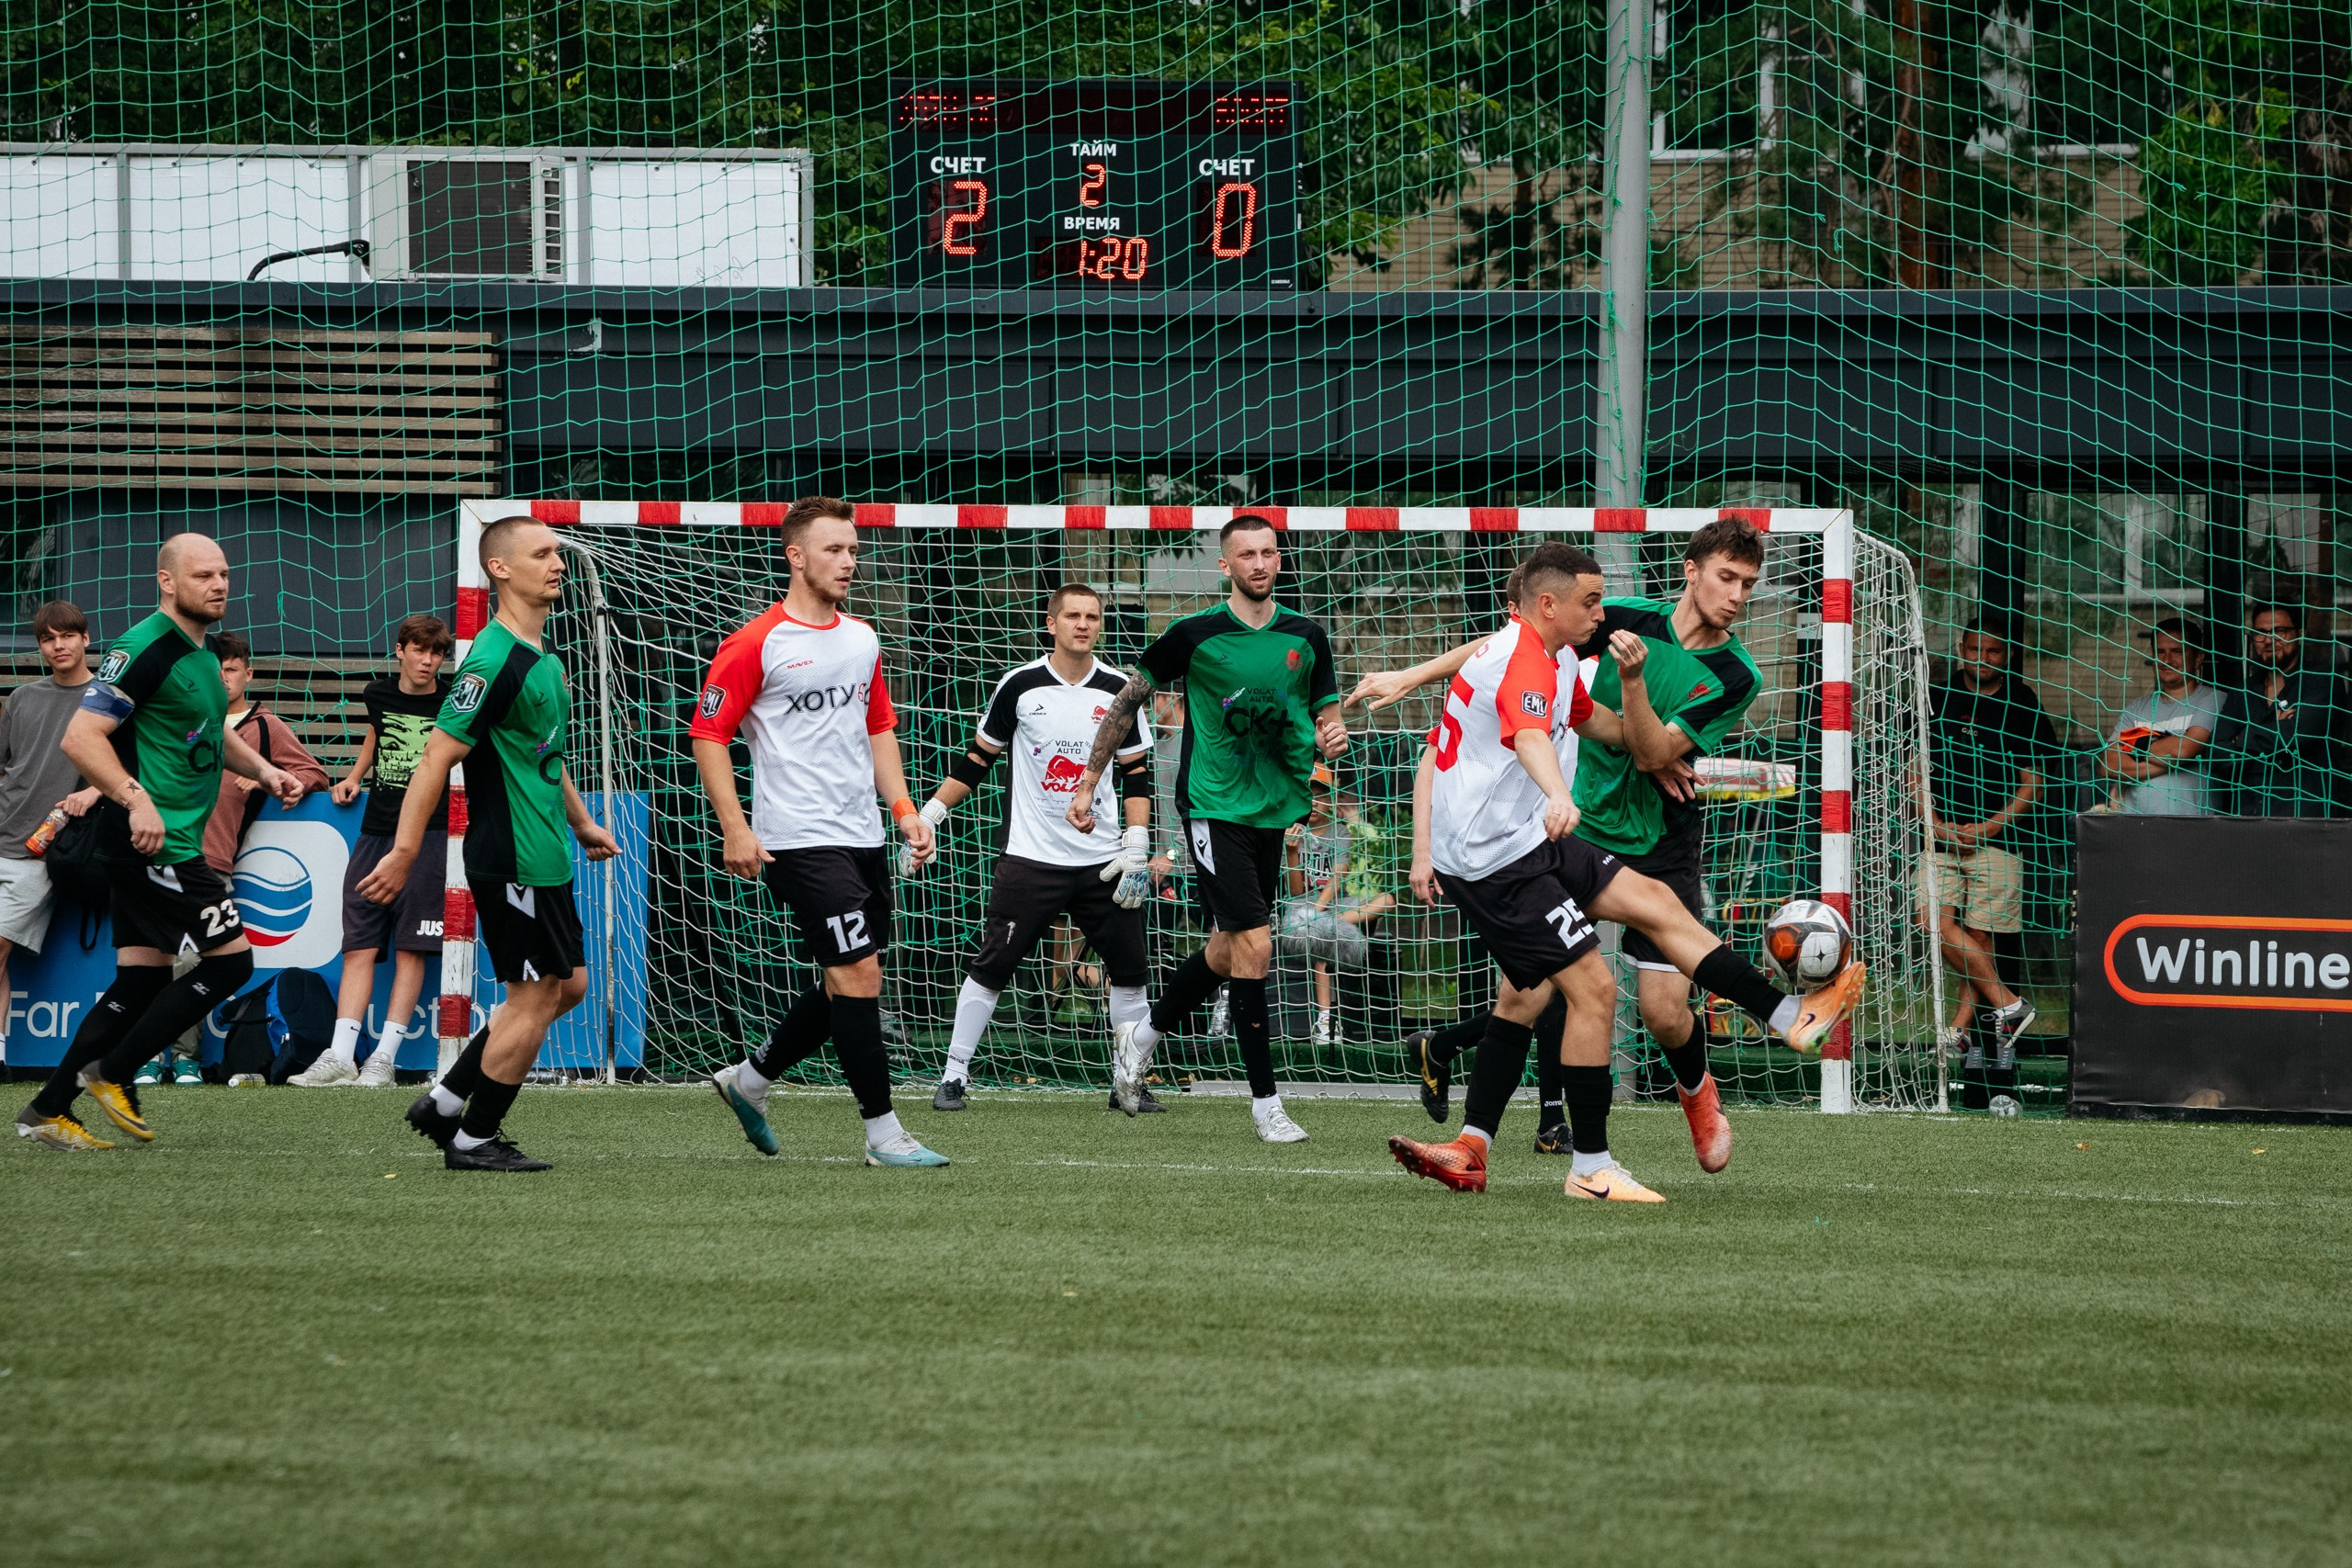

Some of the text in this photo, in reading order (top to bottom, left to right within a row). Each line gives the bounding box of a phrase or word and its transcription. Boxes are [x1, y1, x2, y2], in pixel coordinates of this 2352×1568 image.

[931, 156, 986, 175] СЧЕТ
[1070, 140, 1116, 157] ТАЙМ
[1199, 158, 1255, 176] СЧЕТ
[1080, 164, 1105, 206] 2
[943, 181, 988, 255] 2
[1064, 217, 1120, 231] ВРЕМЯ
[1212, 183, 1256, 257] 0
[1079, 237, 1148, 280] 1:20
[787, 660, 814, 669] MAVEX
[1435, 671, 1475, 773] 5
[1040, 782, 1080, 793] VOLA
[200, 899, 240, 938] 23
[416, 920, 444, 937] JUS
[827, 910, 871, 953] 12
[1545, 897, 1595, 950] 25
[2136, 937, 2351, 990] Winline
[5, 991, 79, 1038] Far
